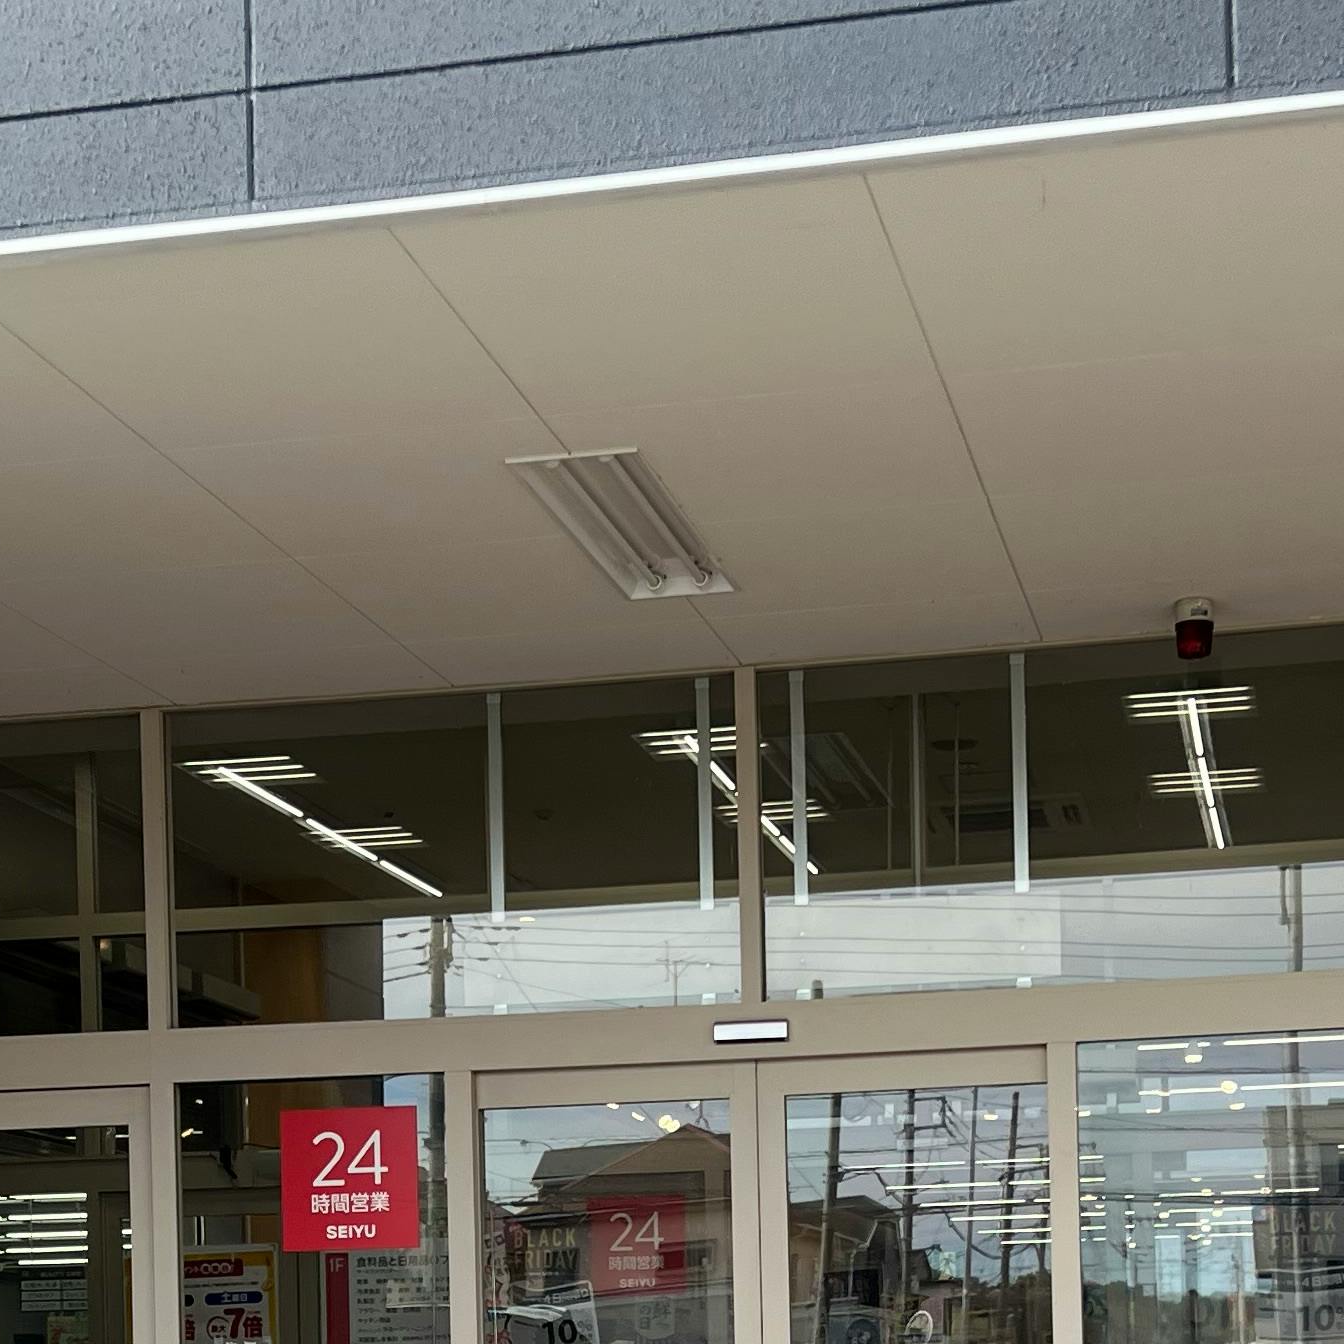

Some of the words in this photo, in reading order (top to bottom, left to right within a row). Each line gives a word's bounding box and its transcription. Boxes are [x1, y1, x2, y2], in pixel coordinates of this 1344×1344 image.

[312, 1129, 389, 1188] 24
[311, 1192, 390, 1214] 時間営業
[326, 1224, 376, 1239] SEIYU
[514, 1227, 576, 1249] BLACK
[610, 1211, 665, 1253] 24
[329, 1257, 345, 1273] 1F
[514, 1250, 577, 1271] FRIDAY
[608, 1255, 665, 1271] 時間営業
[619, 1278, 656, 1289] SEIYU
